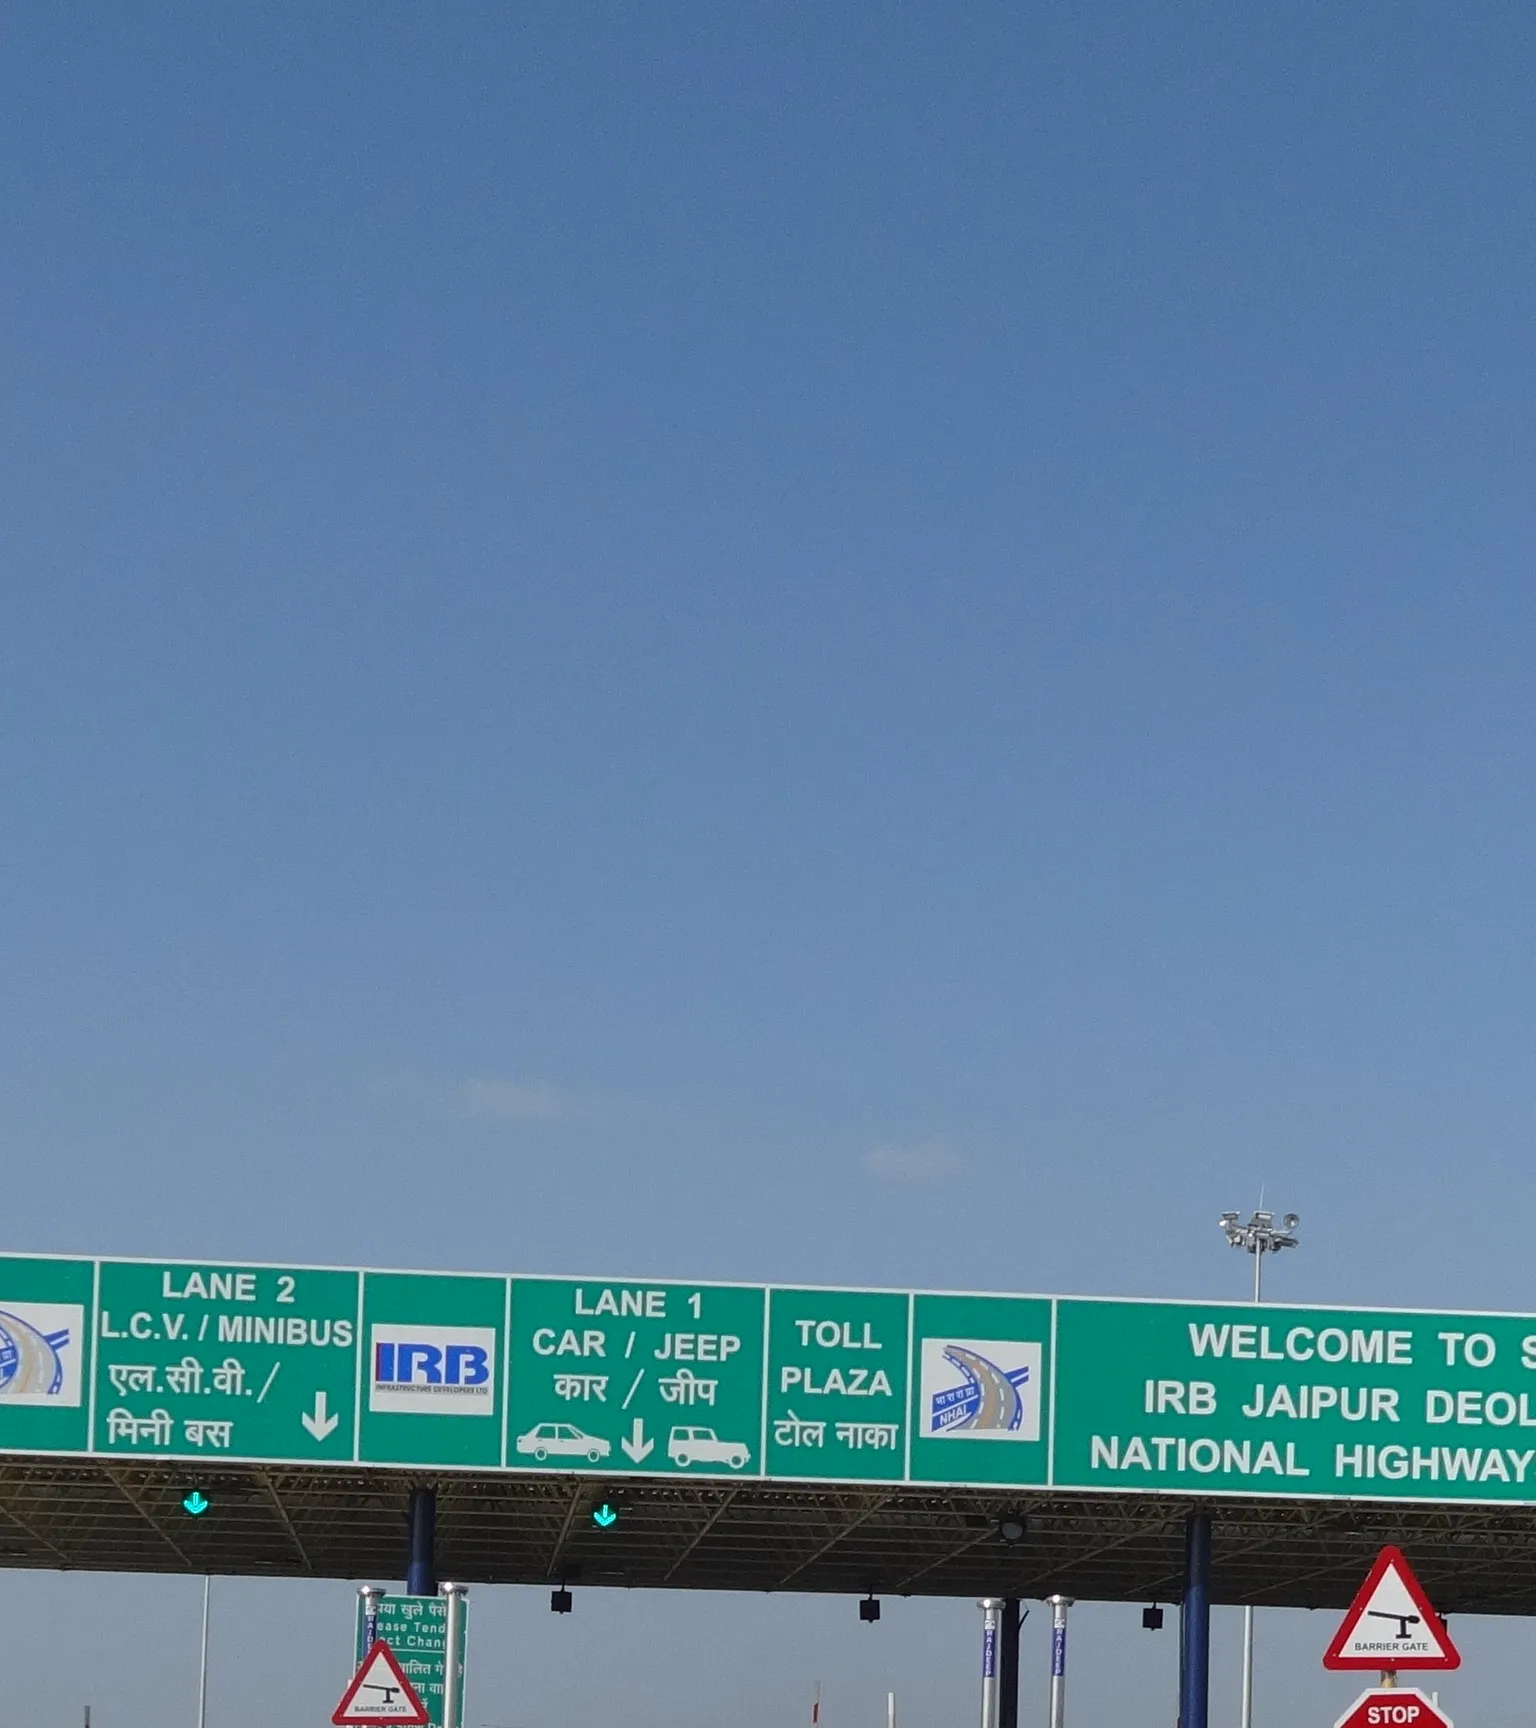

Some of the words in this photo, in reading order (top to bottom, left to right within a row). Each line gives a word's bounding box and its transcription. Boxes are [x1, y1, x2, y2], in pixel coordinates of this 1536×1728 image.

[162, 1271, 256, 1301] LANE
[276, 1276, 295, 1303] 2
[575, 1288, 666, 1318] LANE
[687, 1292, 701, 1319] 1
[101, 1311, 189, 1340] L.C.V.
[217, 1315, 353, 1347] MINIBUS
[532, 1328, 606, 1358] CAR
[654, 1332, 741, 1362] JEEP
[795, 1319, 883, 1349] TOLL
[1188, 1322, 1414, 1365] WELCOME
[1437, 1331, 1496, 1368] TO
[375, 1342, 490, 1385] IRB
[553, 1374, 609, 1402] कार
[658, 1368, 719, 1406] जीप
[780, 1366, 893, 1397] PLAZA
[939, 1404, 967, 1426] NHAI
[1145, 1379, 1217, 1415] IRB
[1242, 1383, 1400, 1423] JAIPUR
[106, 1408, 174, 1445] मिनी
[183, 1420, 234, 1448] बस
[773, 1409, 826, 1448] टोल
[835, 1422, 899, 1450] नाका
[1090, 1434, 1310, 1477] NATIONAL
[400, 1601, 423, 1620] खुले
[377, 1622, 407, 1632] ease
[414, 1622, 445, 1634] Tend
[407, 1636, 445, 1650] Chan
[1354, 1642, 1400, 1651] BARRIER
[1402, 1642, 1429, 1651] GATE
[1367, 1706, 1421, 1724] STOP
